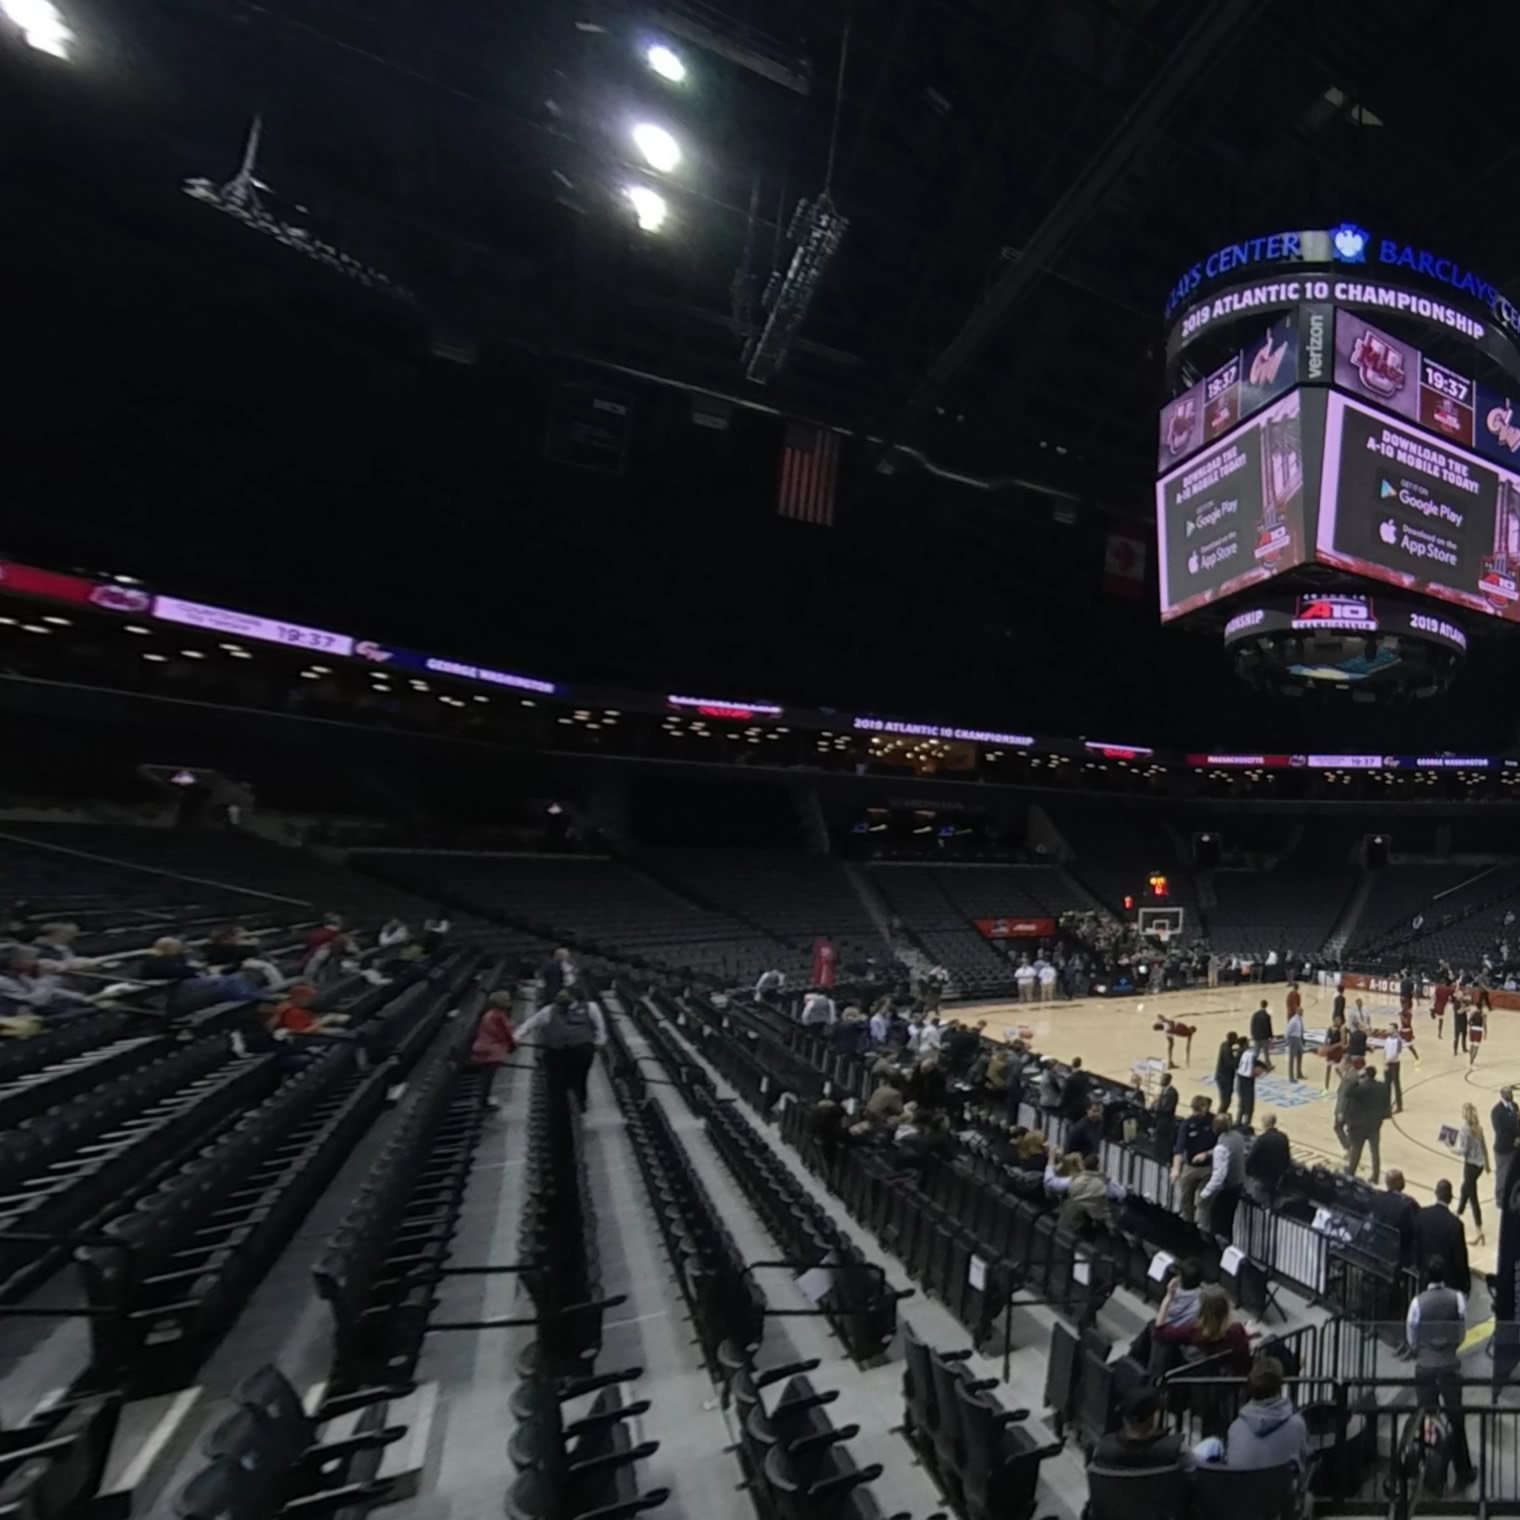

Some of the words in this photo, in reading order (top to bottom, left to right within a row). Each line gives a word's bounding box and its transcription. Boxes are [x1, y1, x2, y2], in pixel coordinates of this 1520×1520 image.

[1205, 231, 1301, 278] CENTER
[1379, 239, 1499, 311] BARCLAYS
[1182, 305, 1212, 337] 2019
[1212, 282, 1300, 318] ATLANTIC
[1304, 281, 1329, 299] 10
[1334, 282, 1485, 340] CHAMPIONSHIP
[1305, 315, 1324, 379] verizon
[1425, 366, 1468, 400] 19:37
[1366, 436, 1394, 456] A-10
[1396, 449, 1440, 479] MOBILE
[1442, 469, 1480, 494] TODAY!
[1382, 429, 1446, 467] DOWNLOAD
[1449, 459, 1469, 478] THE
[1195, 507, 1221, 529] Google
[1221, 499, 1238, 515] Play
[1399, 489, 1439, 516] Google
[1440, 504, 1463, 528] Play
[1402, 524, 1436, 544] Download
[1201, 553, 1217, 570] App
[1216, 542, 1238, 561] Store
[1401, 535, 1426, 558] App
[1427, 546, 1457, 566] Store
[1301, 602, 1368, 619] A10
[1410, 613, 1439, 633] 2019
[853, 717, 883, 730] 2019
[884, 721, 939, 737] ATLANTIC
[940, 727, 953, 738] 10
[954, 729, 1035, 747] CHAMPIONSHIP
[1369, 978, 1388, 990] A-10
